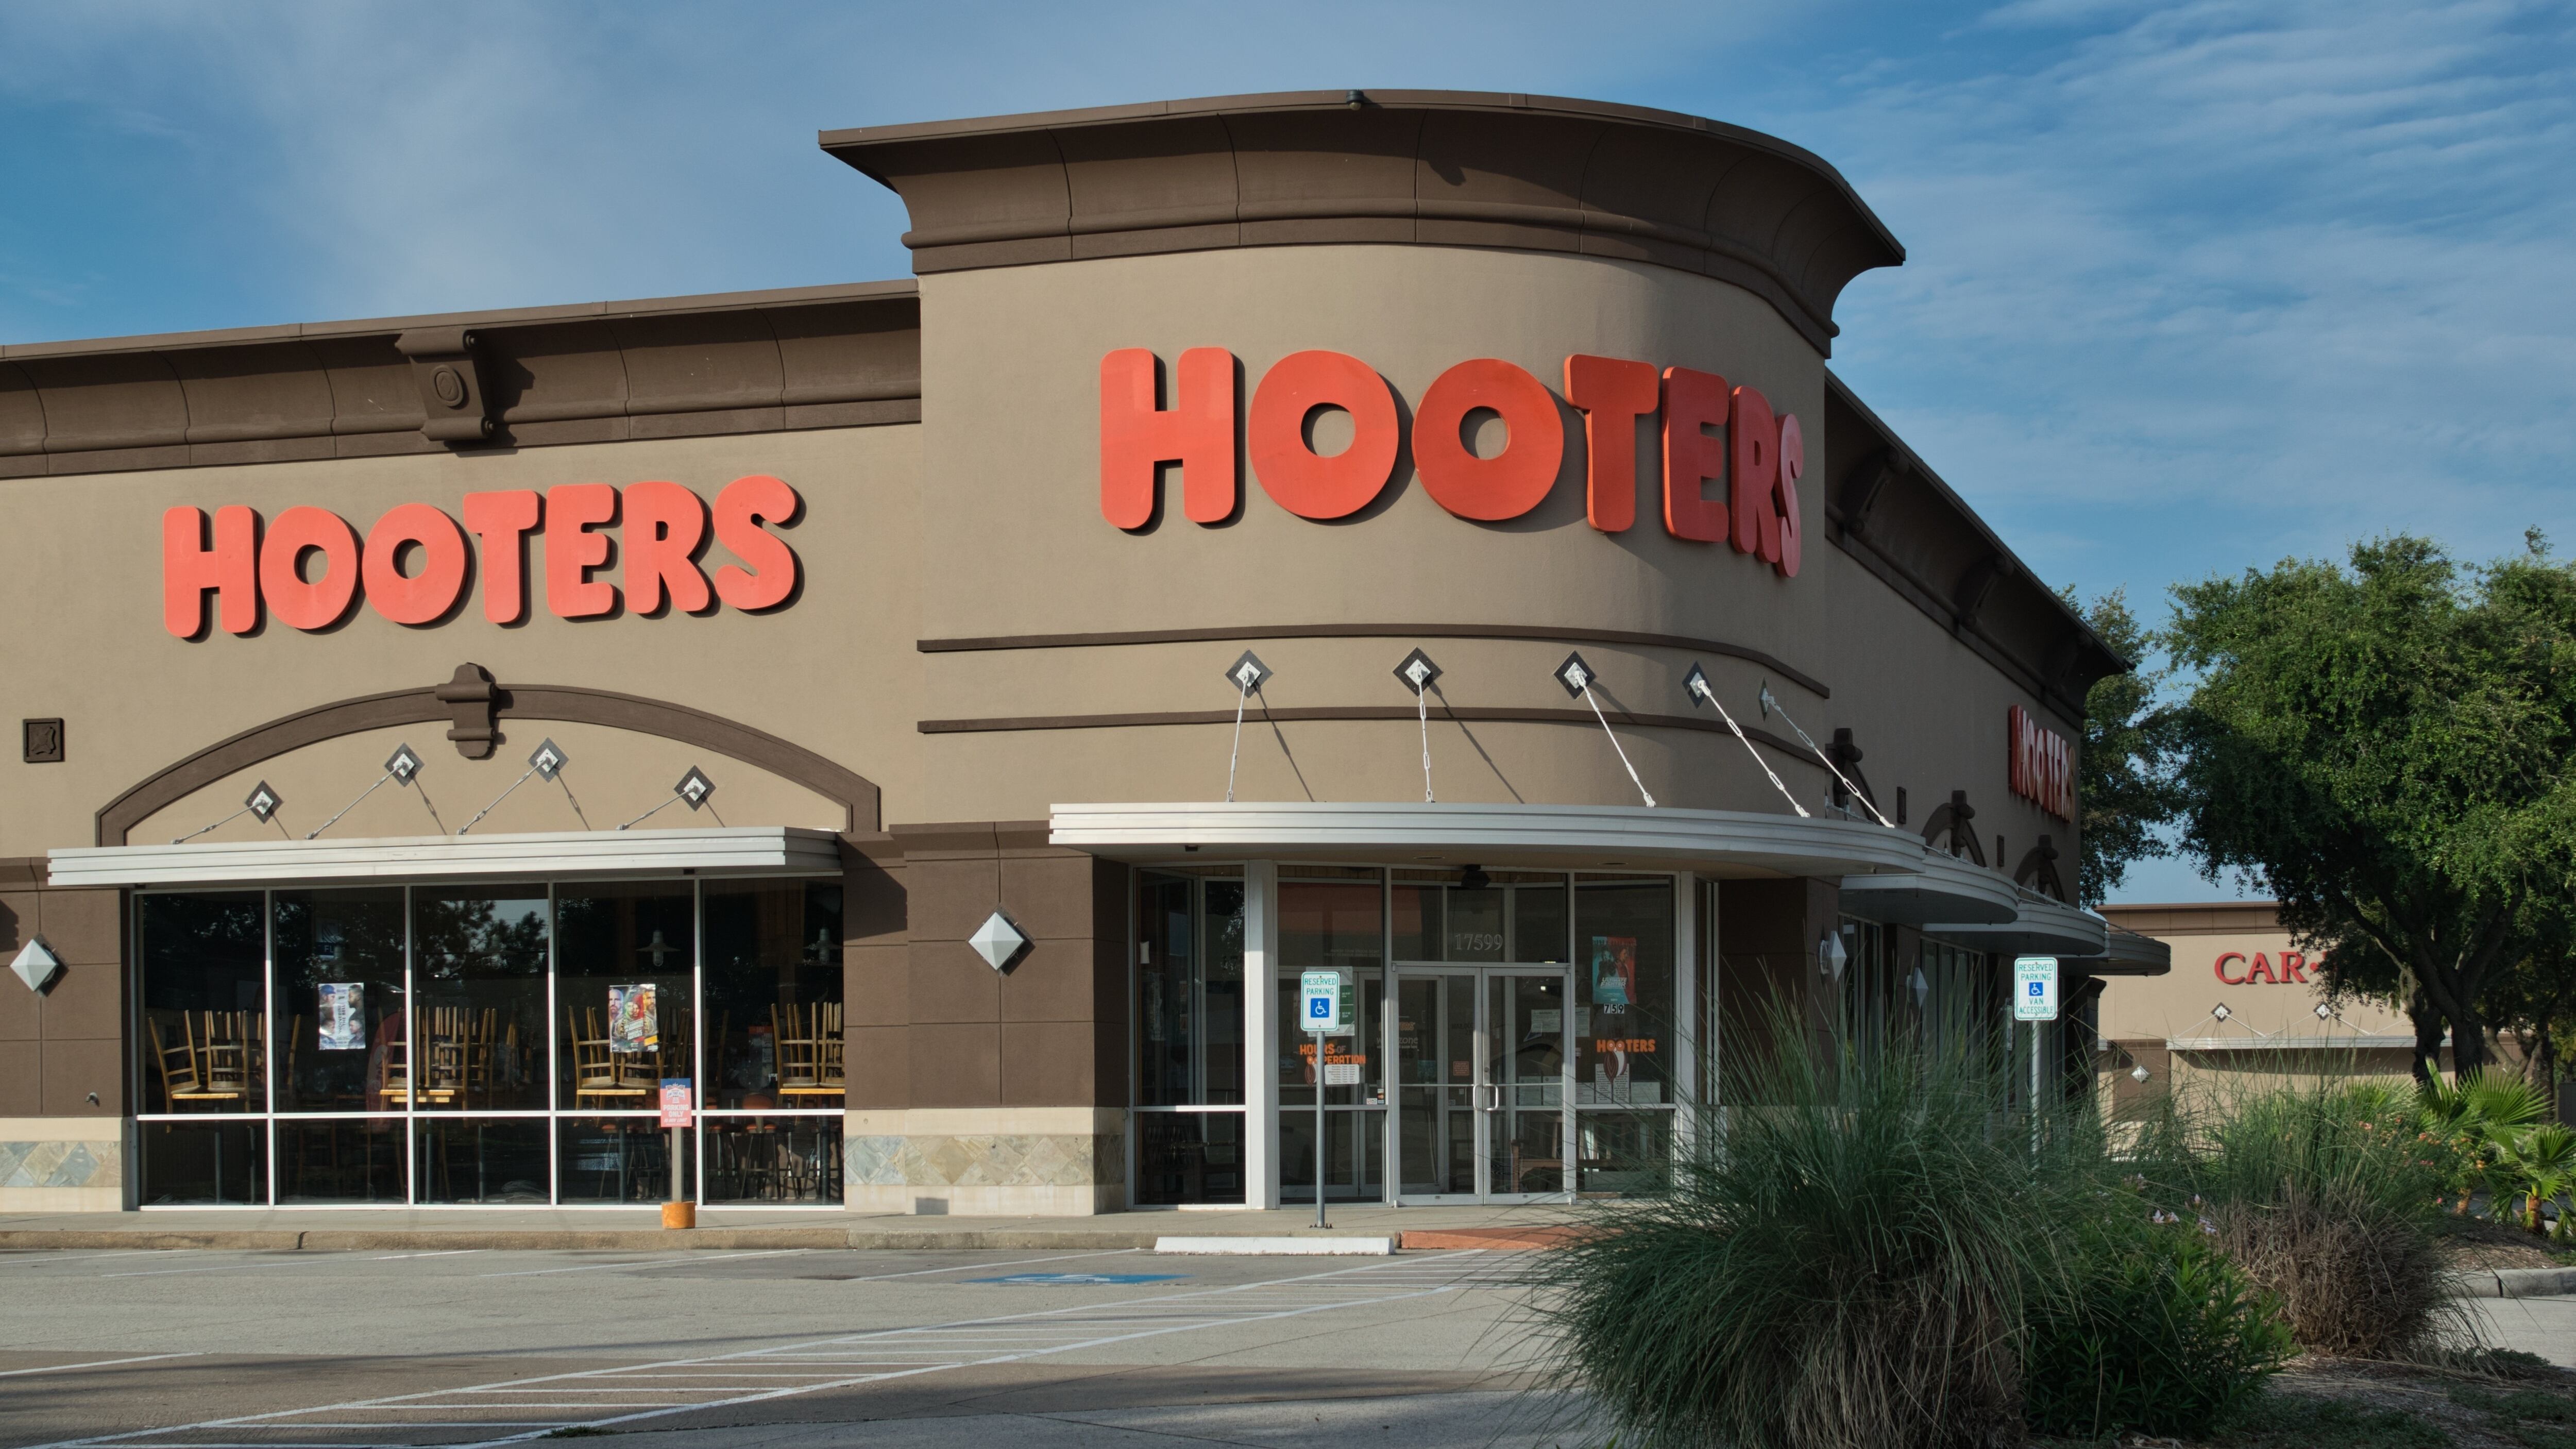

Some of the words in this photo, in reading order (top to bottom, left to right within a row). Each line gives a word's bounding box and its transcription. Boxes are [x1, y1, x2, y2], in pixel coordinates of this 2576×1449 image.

[1100, 346, 1804, 578] HOOTERS
[162, 474, 802, 638] HOOTERS
[2010, 704, 2076, 824] HOOTERS
[1454, 934, 1503, 951] 17599
[1604, 1004, 1624, 1014] 759
[1300, 1043, 1335, 1055] HORS
[1597, 1039, 1656, 1053] HOOTERS
